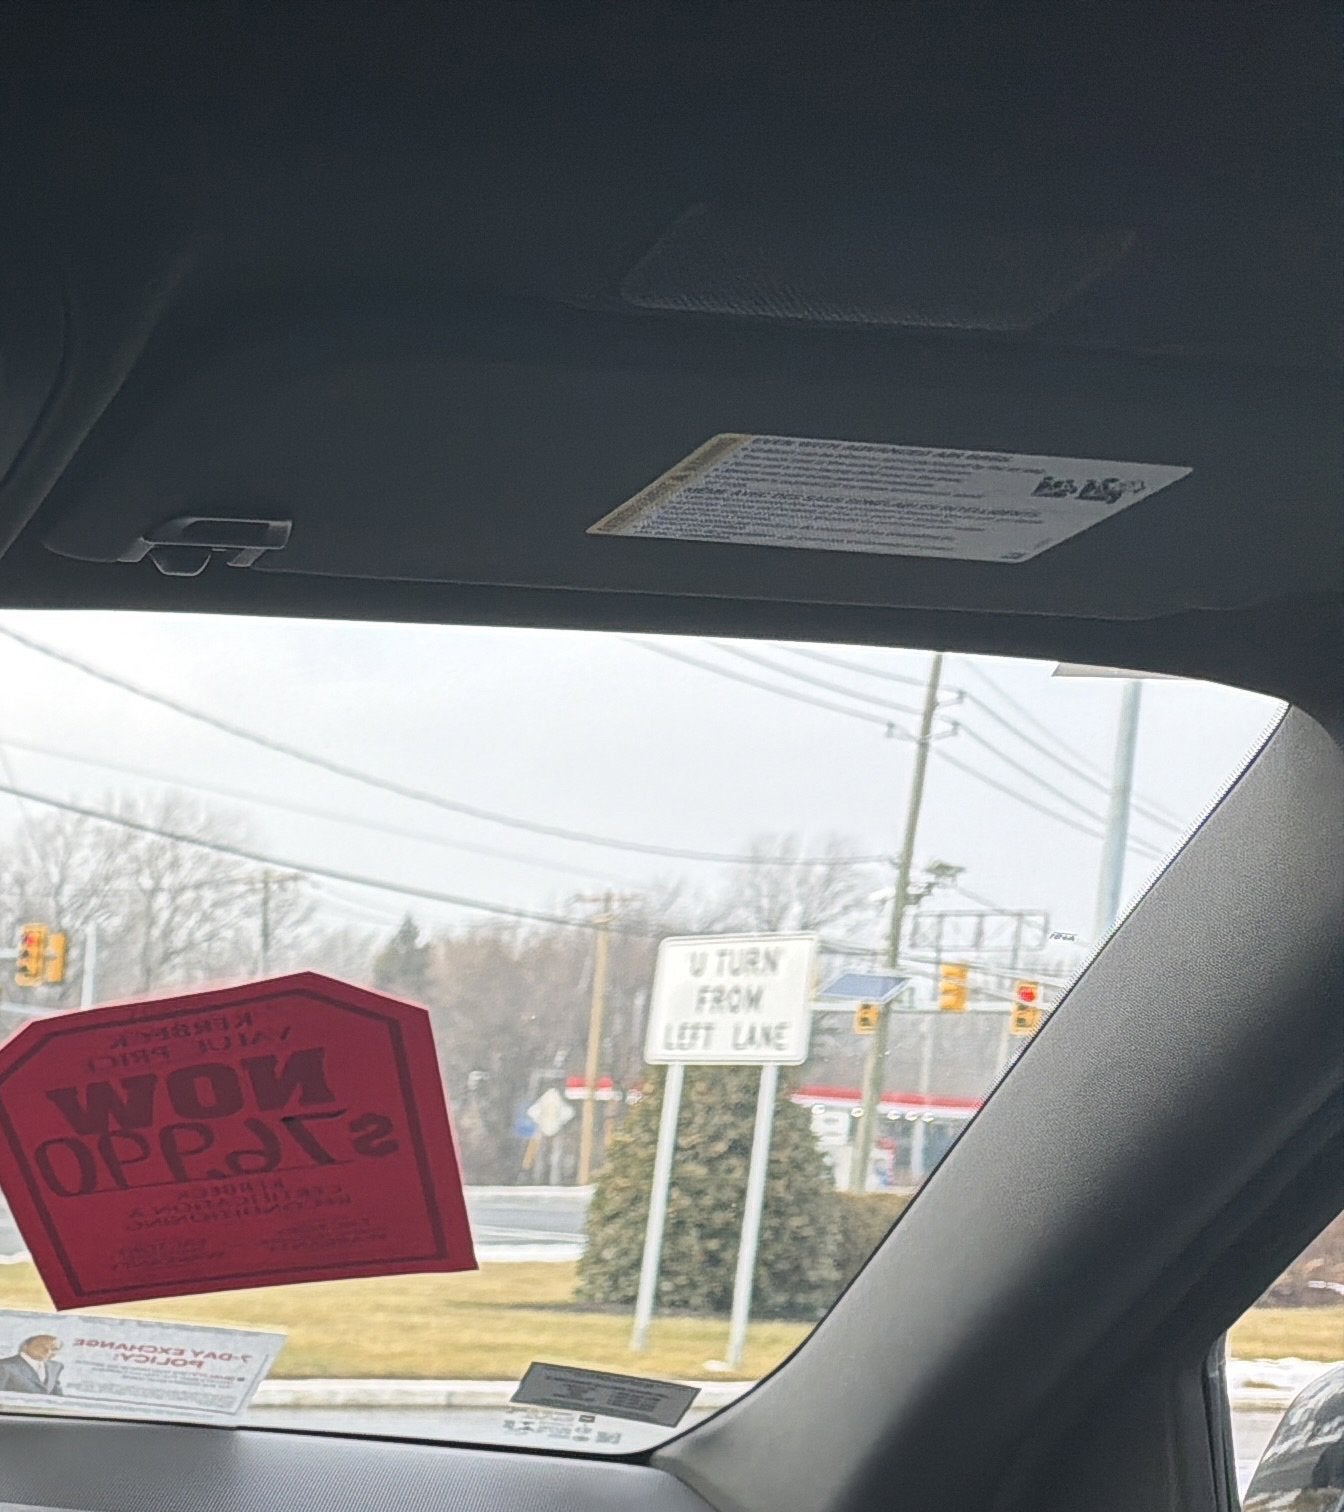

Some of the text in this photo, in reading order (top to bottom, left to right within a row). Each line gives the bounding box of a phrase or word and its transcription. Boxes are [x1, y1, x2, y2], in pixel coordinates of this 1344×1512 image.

[715, 946, 783, 975] TURN
[695, 985, 762, 1013] FROM
[663, 1021, 789, 1050] LEFT LANE
